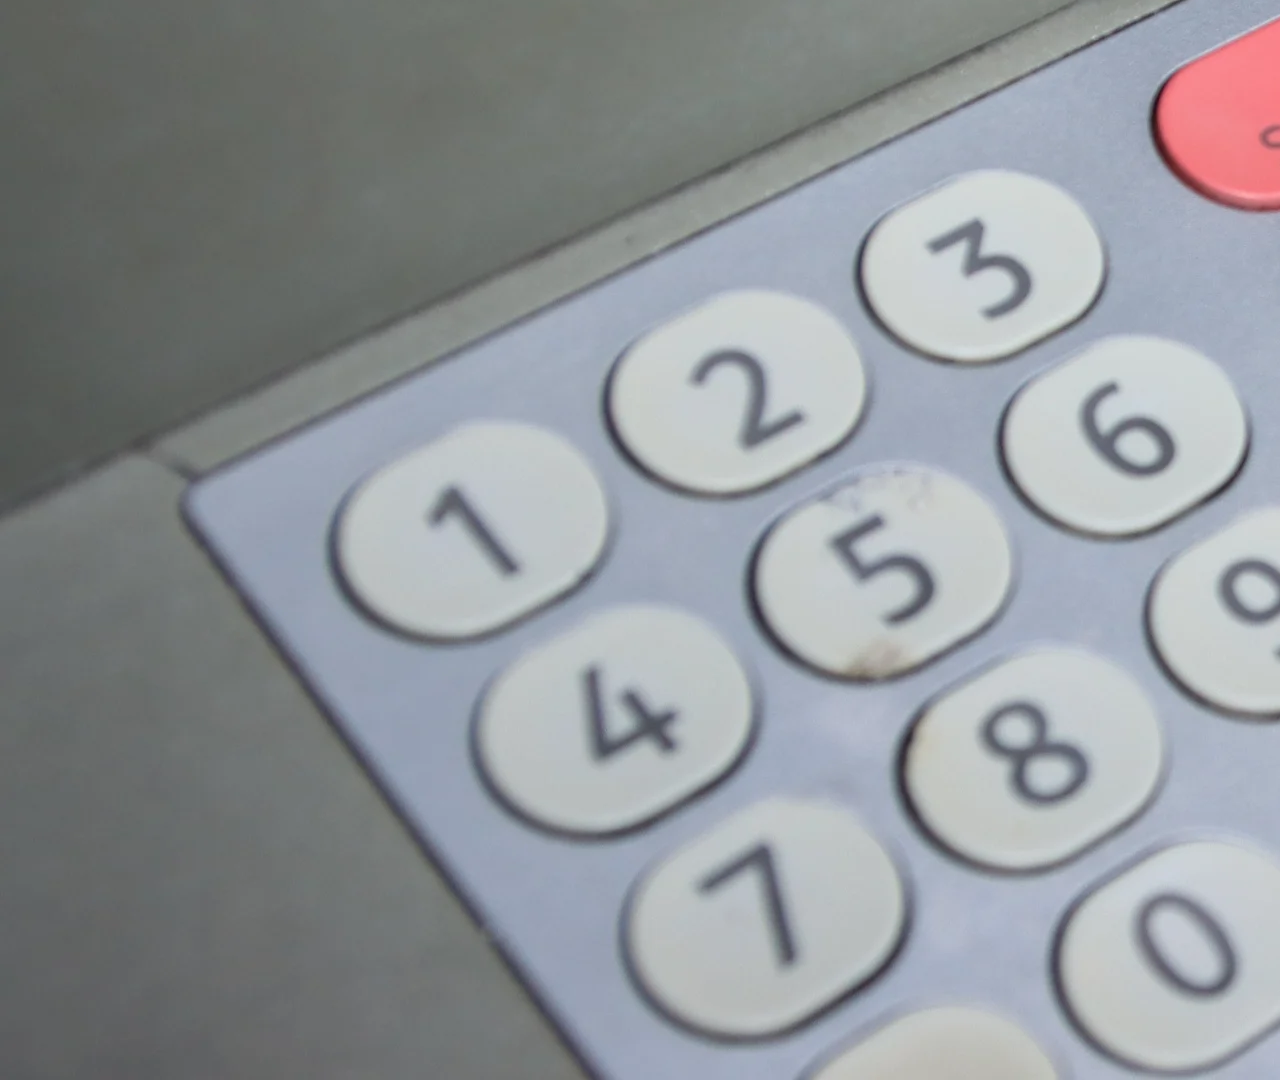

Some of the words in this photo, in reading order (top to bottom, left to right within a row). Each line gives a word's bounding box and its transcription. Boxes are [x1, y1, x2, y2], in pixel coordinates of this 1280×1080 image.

[924, 215, 1036, 323] 3
[687, 346, 807, 453] 2
[1077, 379, 1180, 481] 6
[426, 483, 523, 579] 1
[826, 511, 940, 629] 5
[580, 664, 680, 765] 4
[976, 698, 1093, 810] 8
[695, 840, 802, 971] 7
[1132, 890, 1241, 1002] 0
